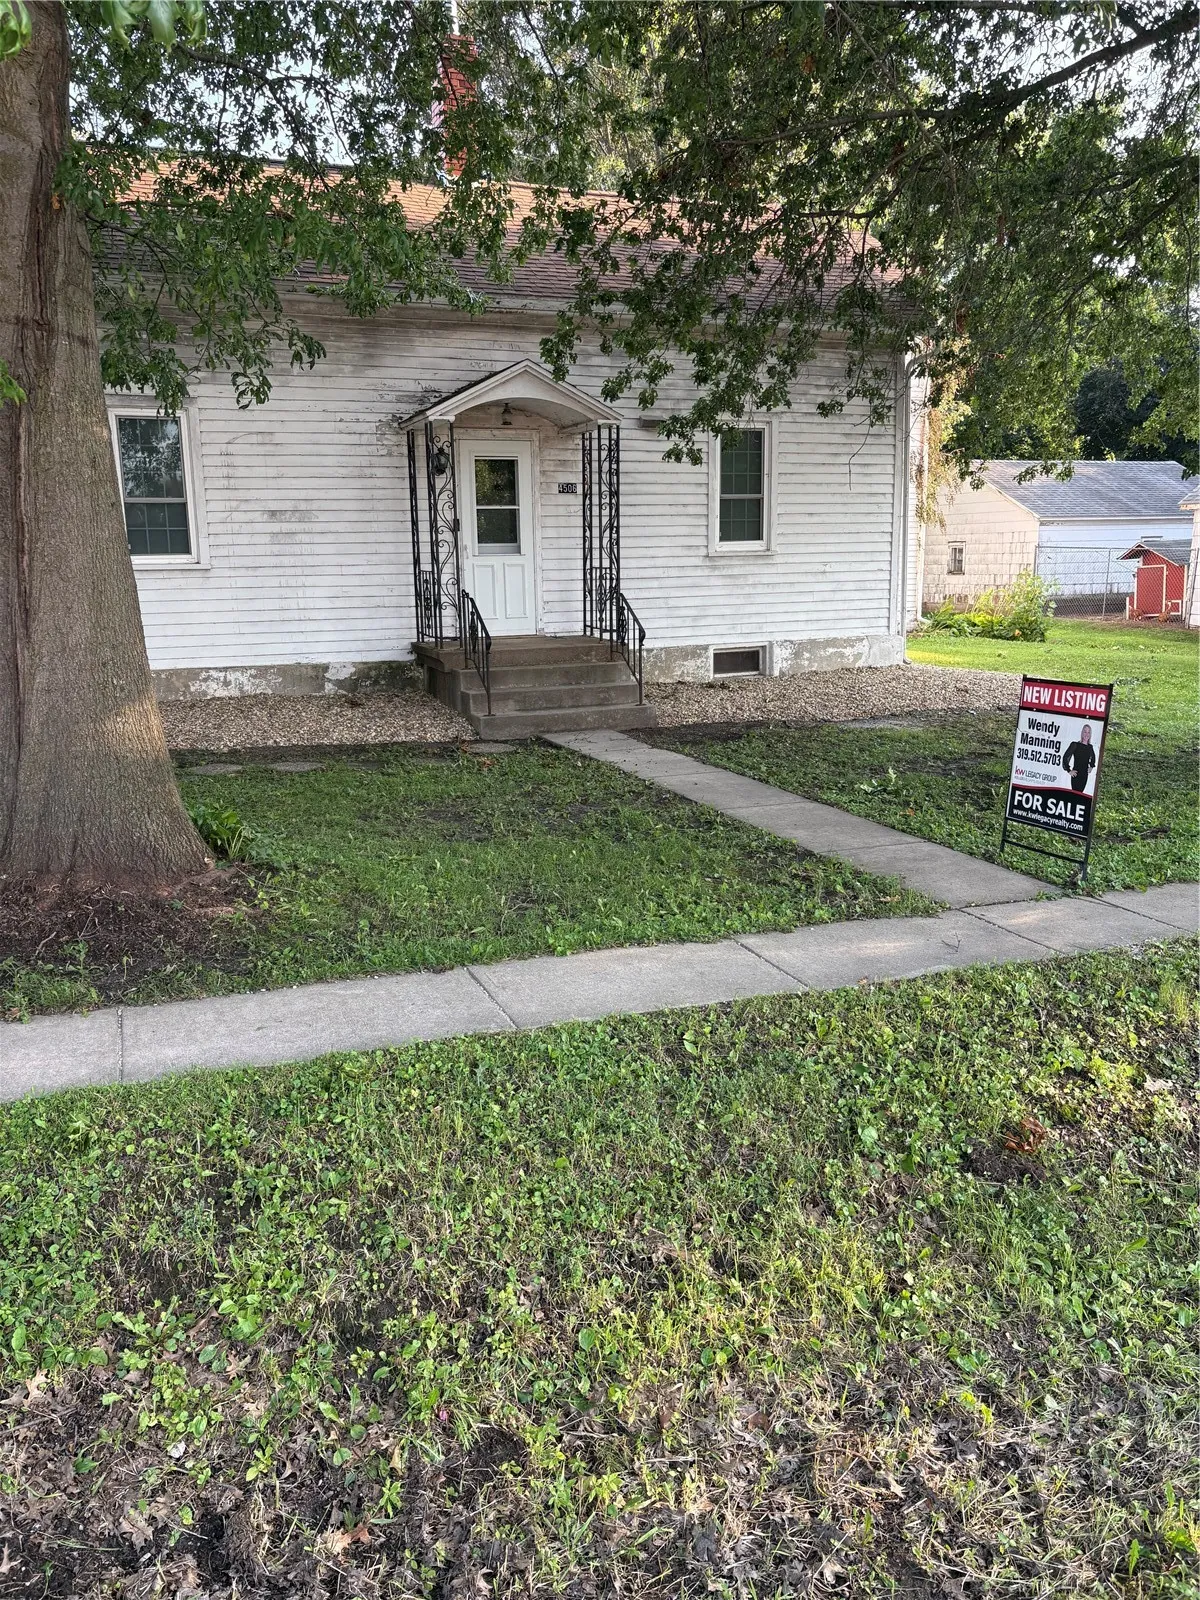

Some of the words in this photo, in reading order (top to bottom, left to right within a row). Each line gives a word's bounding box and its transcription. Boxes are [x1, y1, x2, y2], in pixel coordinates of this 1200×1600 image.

[558, 484, 577, 492] 4506
[1023, 685, 1052, 705] NEW
[1054, 689, 1106, 712] LISTING
[1028, 717, 1060, 737] Wendy
[1020, 732, 1061, 753] Manning
[1016, 747, 1061, 766] 319.512.5703
[1015, 766, 1025, 775] kw
[1025, 770, 1042, 780] LEGACY
[1042, 773, 1057, 782] GROUP
[1014, 790, 1043, 812] FOR
[1046, 798, 1085, 821] SALE
[1013, 809, 1083, 831] www.kwlegacyrealty.com
